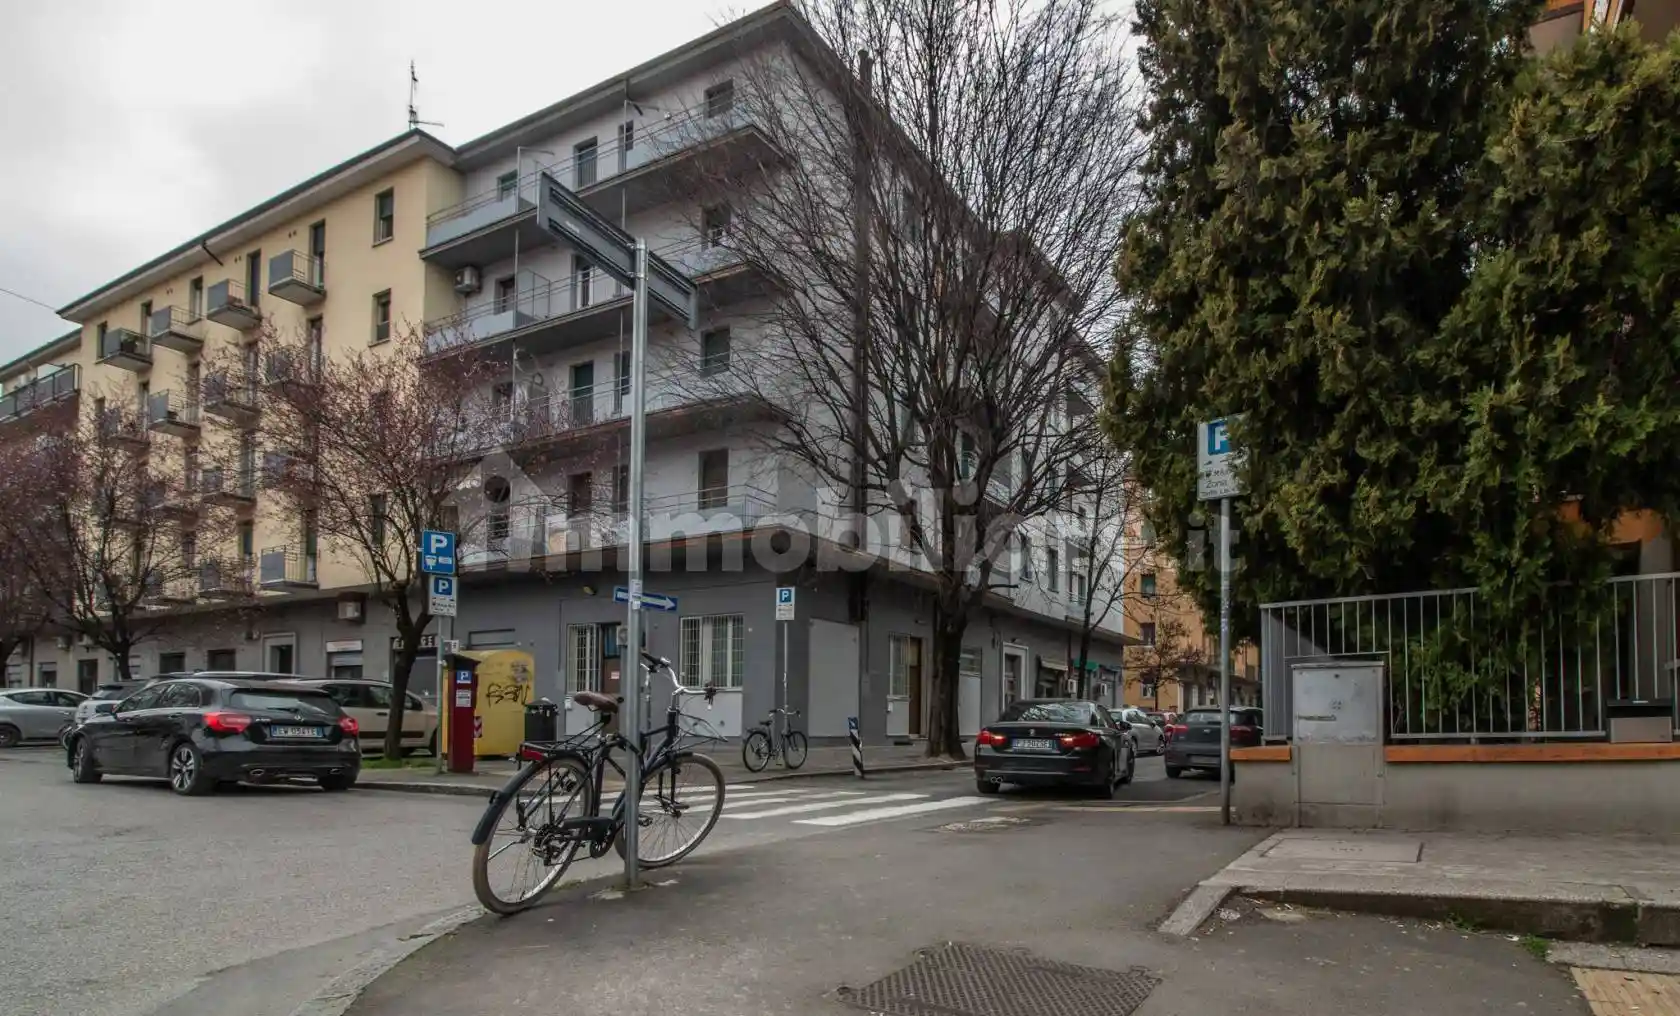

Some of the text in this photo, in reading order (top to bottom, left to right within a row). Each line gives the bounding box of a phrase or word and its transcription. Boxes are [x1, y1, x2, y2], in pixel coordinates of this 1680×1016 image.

[430, 534, 448, 554] P
[438, 579, 449, 593] P
[781, 590, 790, 602] P
[460, 671, 469, 680] P
